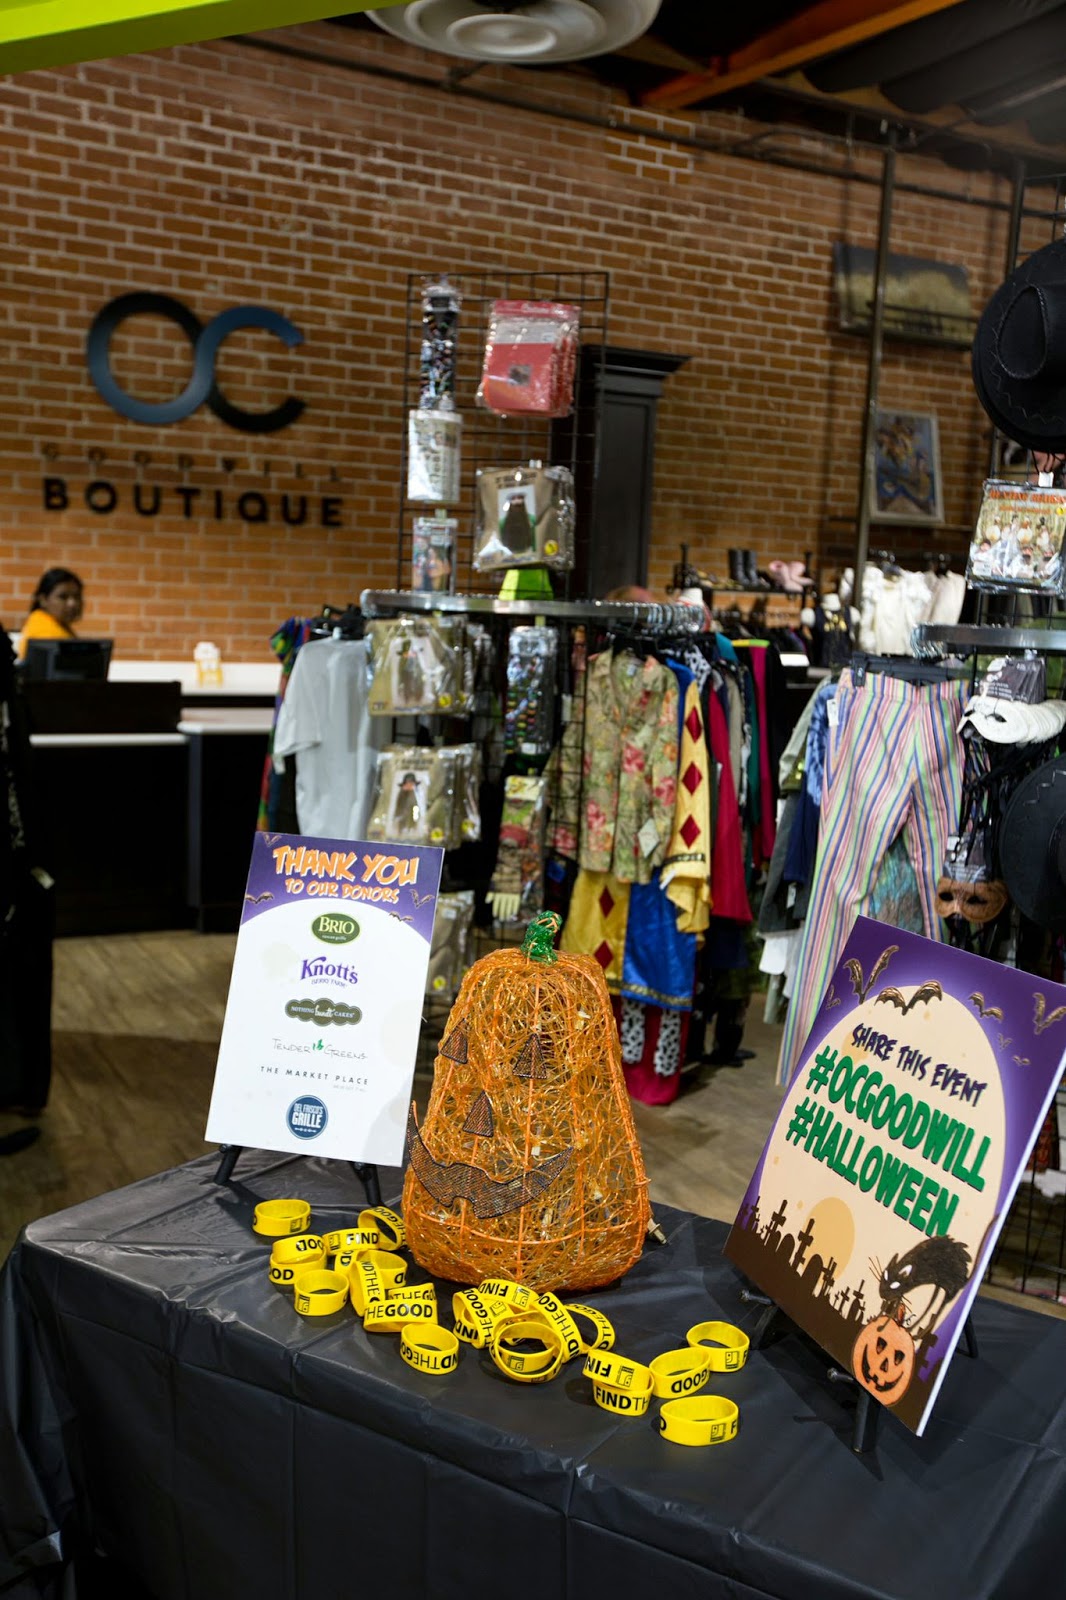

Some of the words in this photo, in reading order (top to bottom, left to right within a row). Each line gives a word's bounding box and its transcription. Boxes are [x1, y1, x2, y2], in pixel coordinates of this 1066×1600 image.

[42, 477, 343, 528] BOUTIQUE
[273, 845, 357, 882] THANK
[362, 853, 419, 886] YOU
[285, 878, 304, 894] TO
[306, 880, 339, 897] OUR
[342, 883, 400, 904] DONORS
[319, 916, 355, 935] BRIO
[300, 956, 358, 985] Knott's
[260, 1066, 279, 1075] THE
[285, 1069, 328, 1081] MARKET
[335, 1075, 368, 1086] PLACE
[851, 1023, 898, 1062] SHARE
[896, 1046, 931, 1081] THIS
[930, 1064, 988, 1108] EVENT
[291, 1111, 323, 1129] GRILLE
[806, 1045, 991, 1192] #OCGOODWILL
[785, 1096, 960, 1238] #HALLOWEEN
[346, 1233, 379, 1245] FIND
[671, 1368, 707, 1393] GOOD
